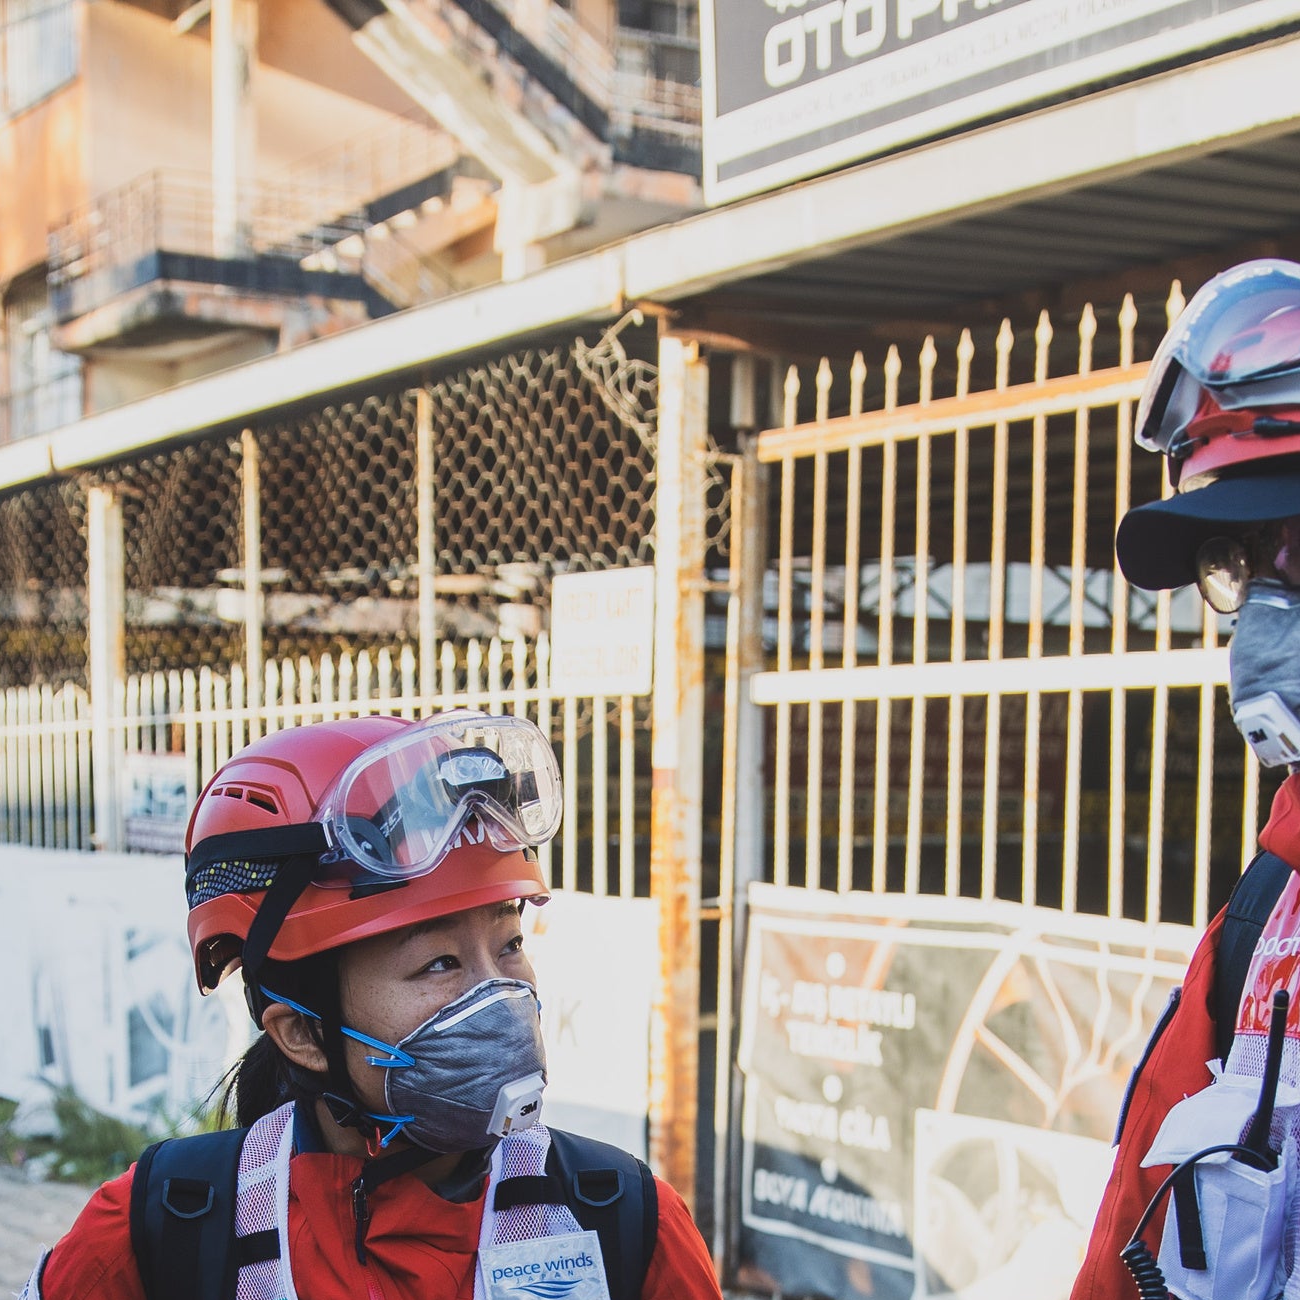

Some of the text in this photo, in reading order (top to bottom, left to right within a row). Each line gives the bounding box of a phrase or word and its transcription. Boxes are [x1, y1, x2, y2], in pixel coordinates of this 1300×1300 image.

[764, 0, 887, 88] OTO
[1247, 727, 1269, 744] 3M
[519, 1100, 538, 1117] 3M
[492, 1251, 593, 1283] peace winds
[516, 1269, 575, 1286] JAPAN
